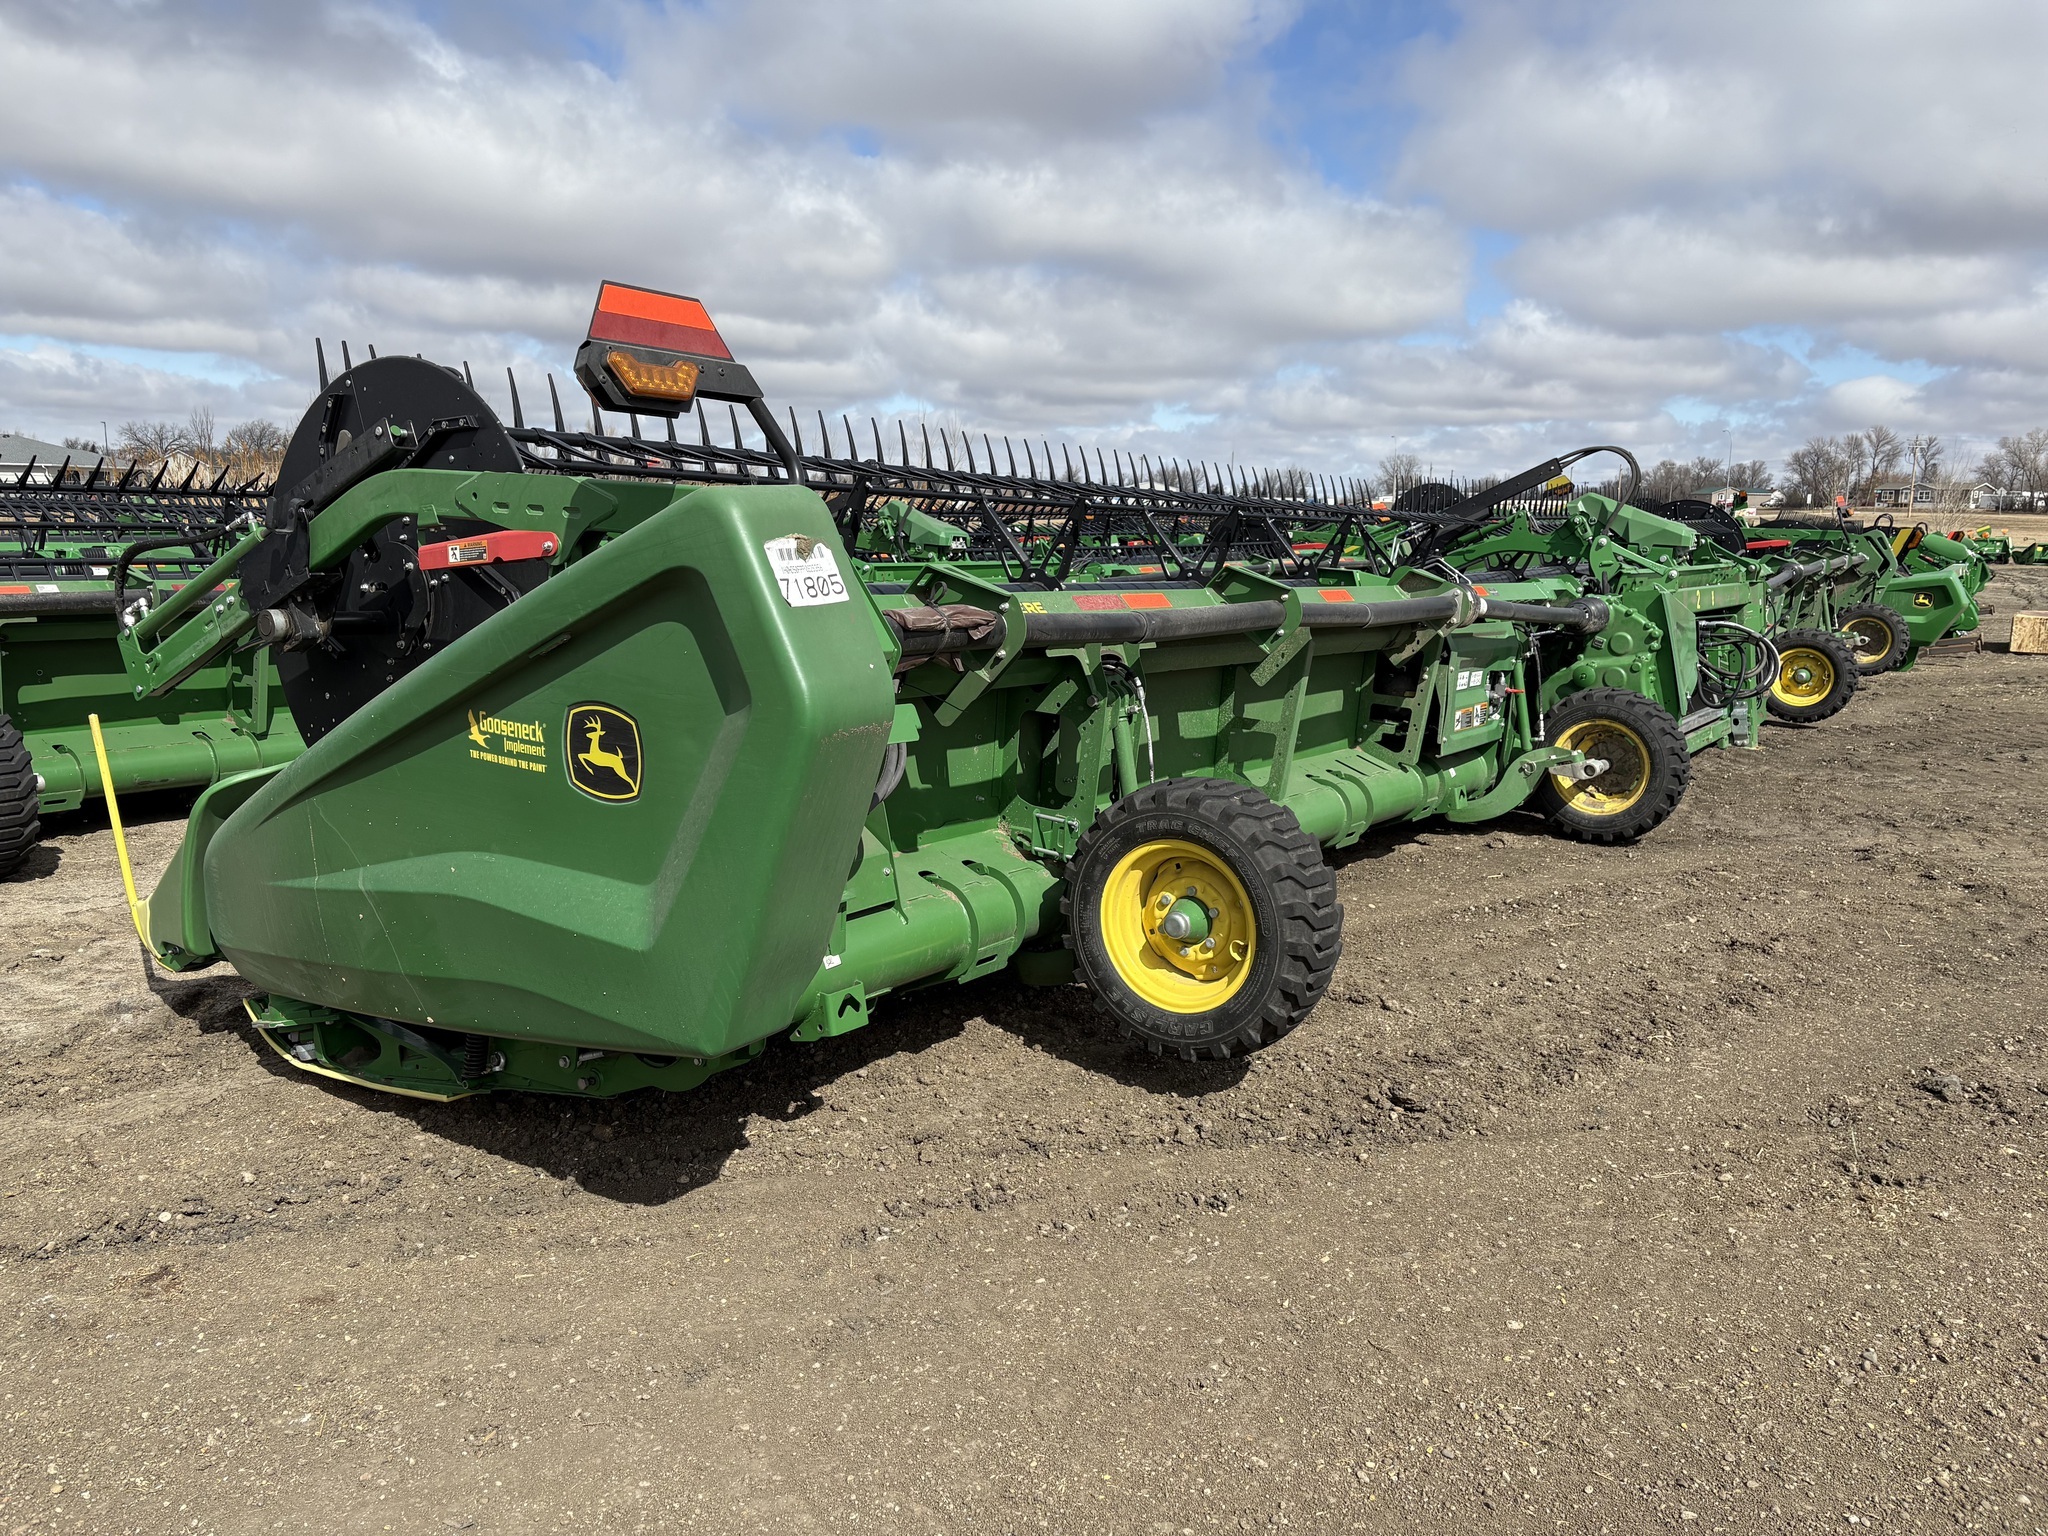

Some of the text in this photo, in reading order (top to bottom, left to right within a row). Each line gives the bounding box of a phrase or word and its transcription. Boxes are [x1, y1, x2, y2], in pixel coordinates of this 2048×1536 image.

[779, 573, 844, 600] 71805
[479, 710, 544, 743] Gooseneck
[469, 749, 546, 773] THE POWER BEHIND THE PAINT
[503, 737, 546, 758] Implement
[1135, 819, 1240, 857] TRAC CHIEF
[1106, 986, 1214, 1037] CARLISLE
